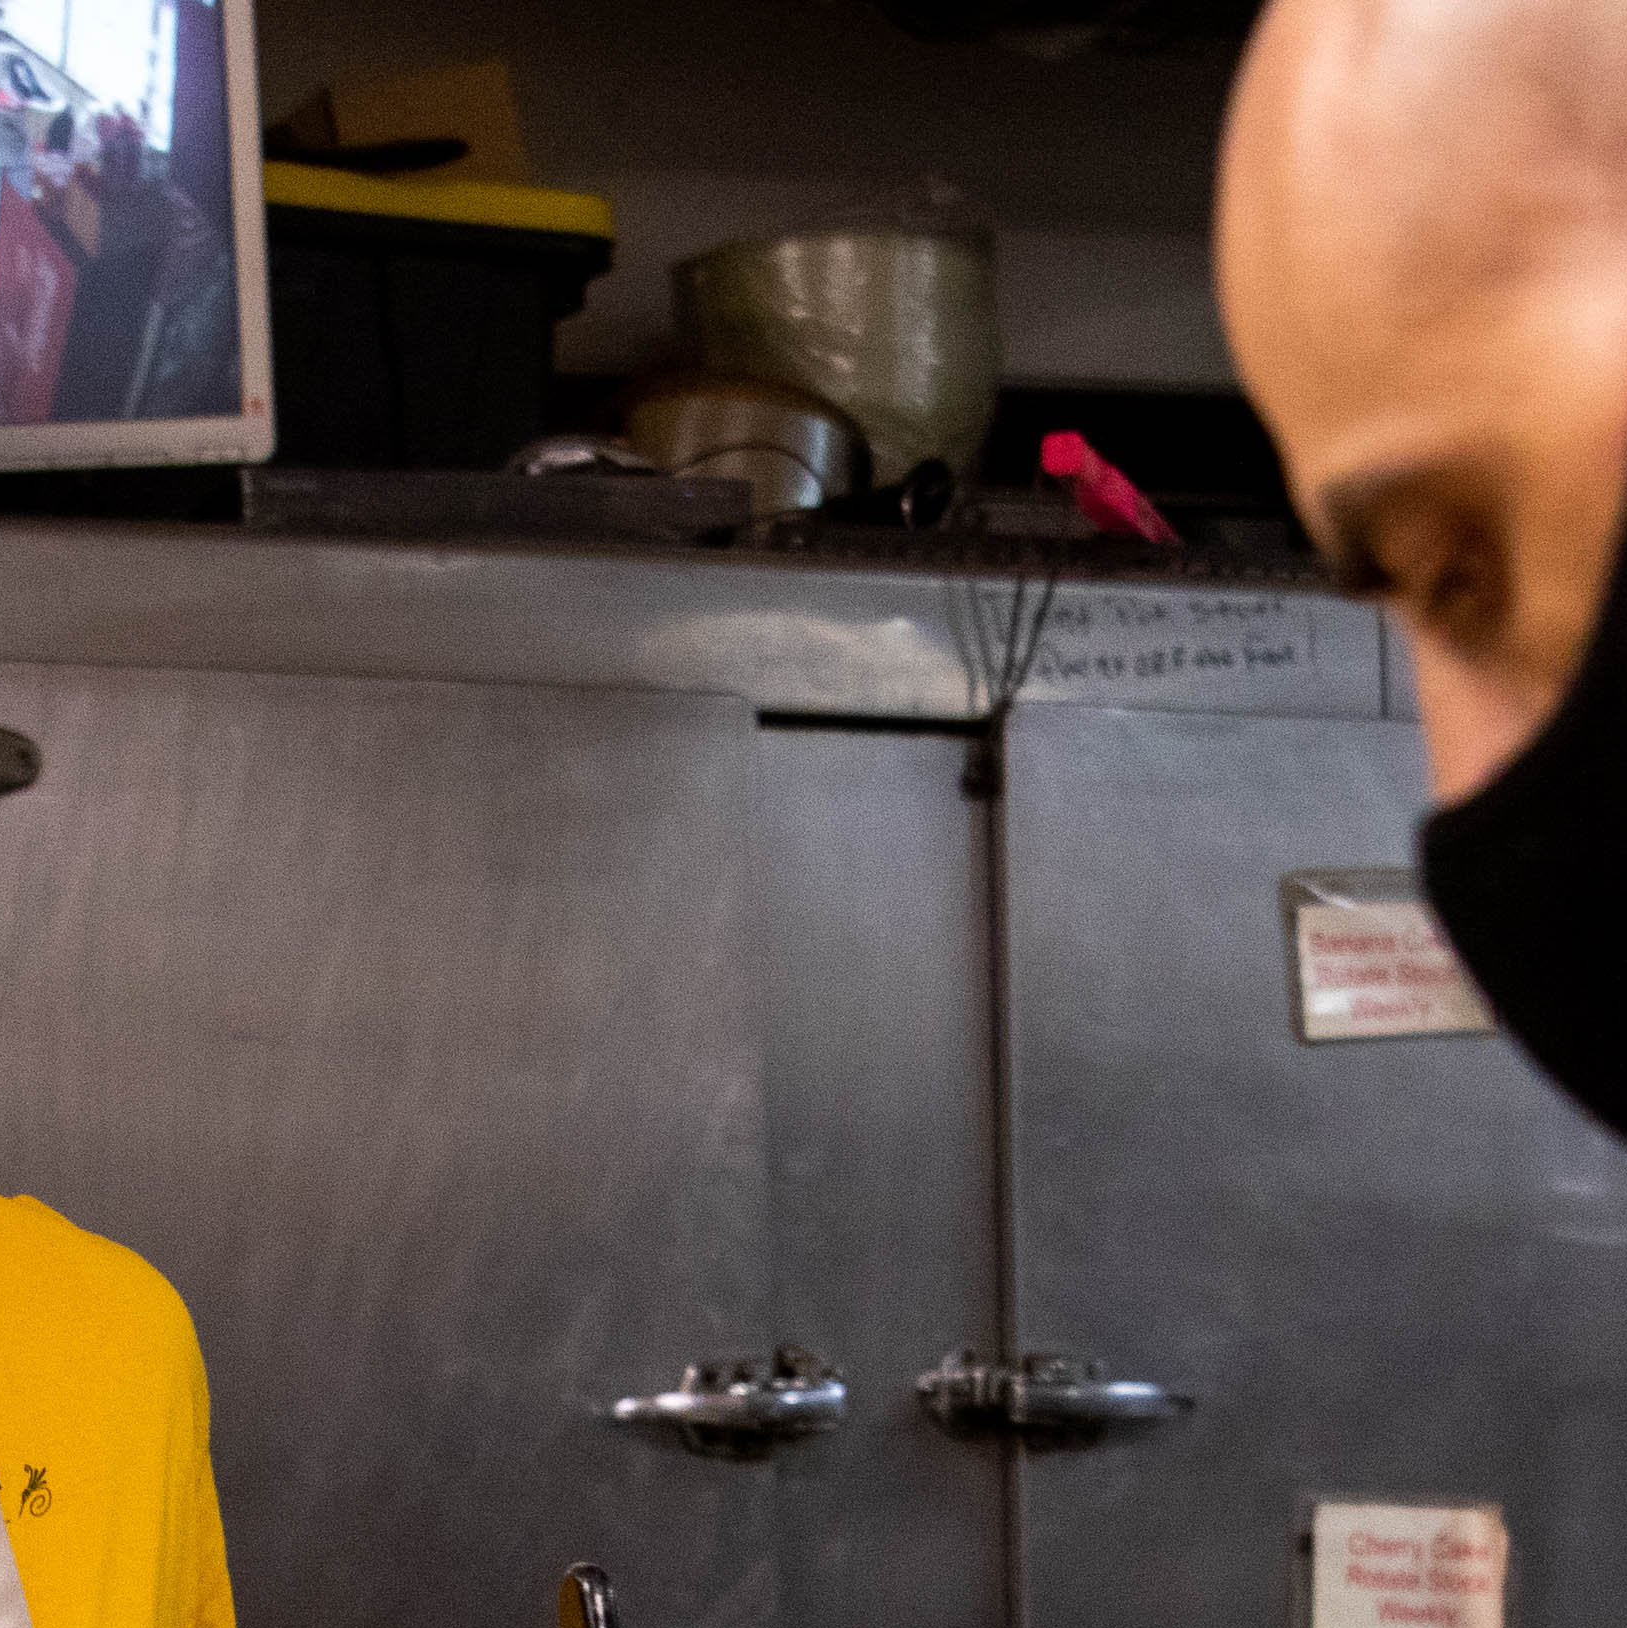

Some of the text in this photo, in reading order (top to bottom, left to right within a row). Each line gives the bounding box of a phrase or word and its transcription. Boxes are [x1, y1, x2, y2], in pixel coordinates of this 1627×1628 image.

[1347, 1531, 1424, 1560] Cherry
[1346, 1563, 1419, 1589] Rotate
[1379, 1600, 1460, 1627] Weekly
